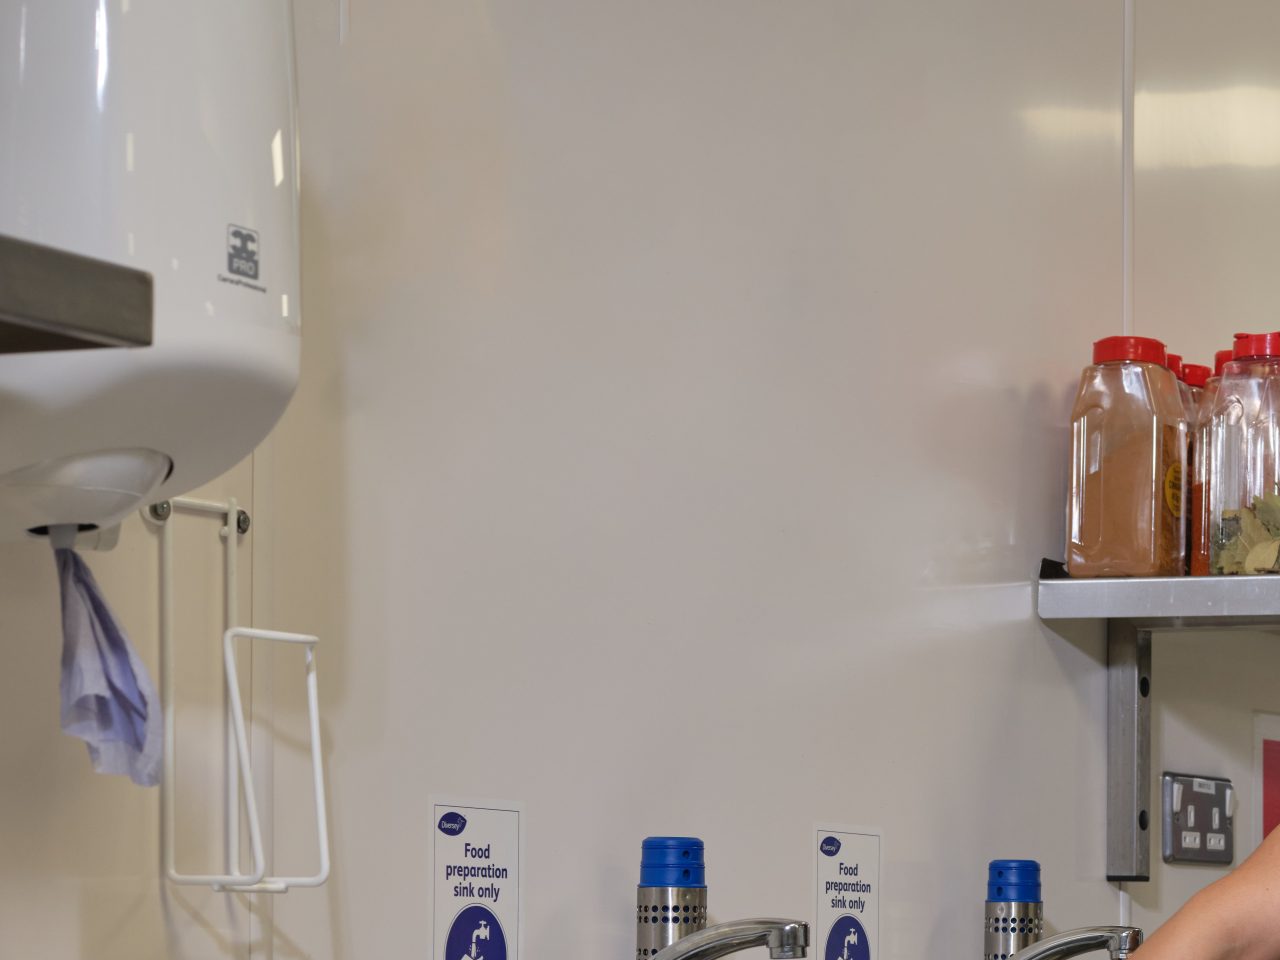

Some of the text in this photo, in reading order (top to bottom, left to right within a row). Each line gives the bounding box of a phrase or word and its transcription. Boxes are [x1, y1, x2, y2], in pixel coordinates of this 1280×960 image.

[232, 257, 256, 276] PRO
[464, 842, 490, 859] Food
[446, 863, 508, 881] preparation
[839, 862, 859, 877] Food
[453, 881, 501, 903] sink only
[825, 880, 871, 894] preparation
[831, 895, 866, 914] sink only
